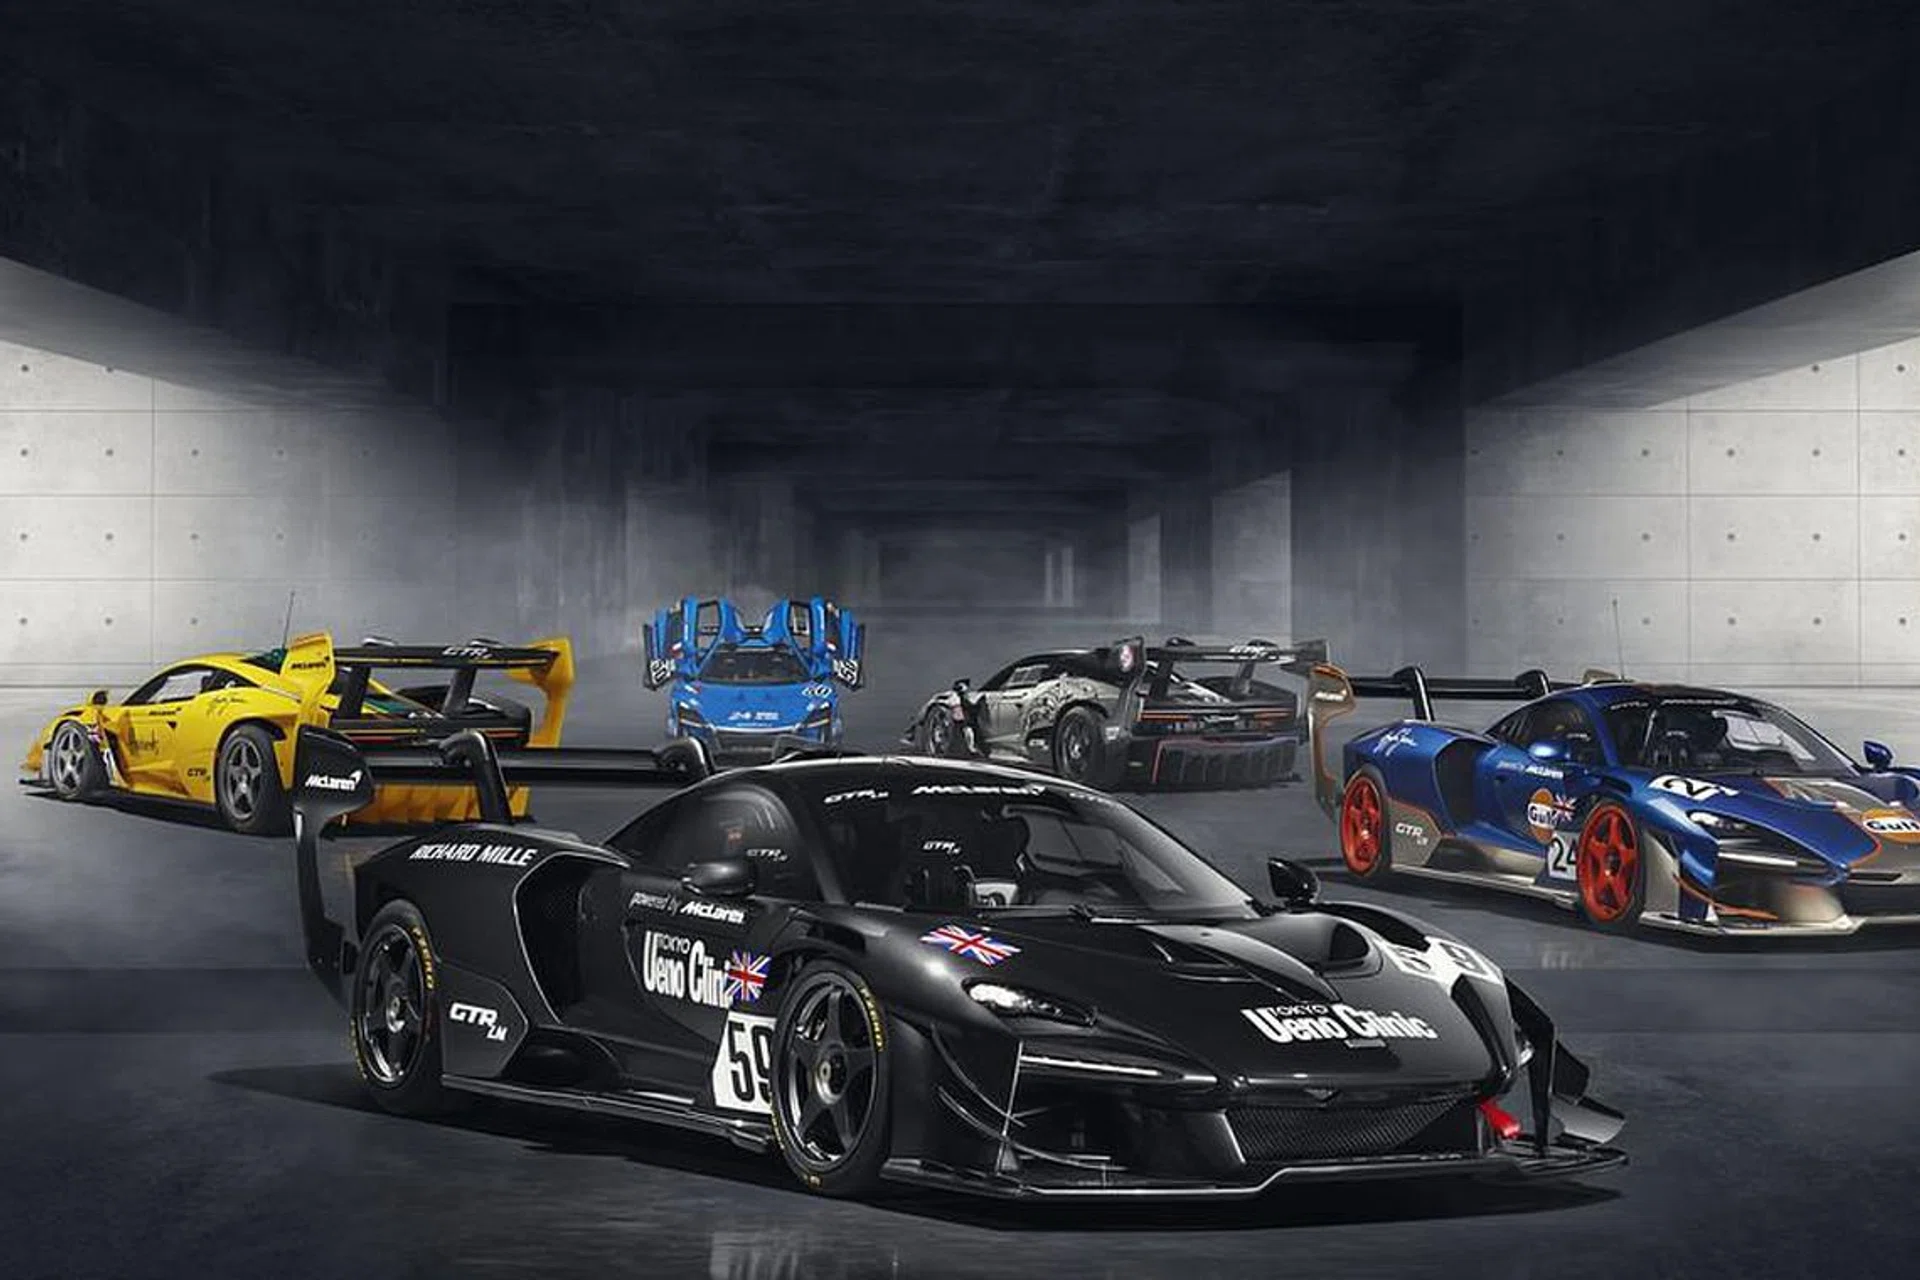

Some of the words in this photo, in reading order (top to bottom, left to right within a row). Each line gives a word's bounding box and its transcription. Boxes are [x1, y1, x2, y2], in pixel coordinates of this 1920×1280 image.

[305, 774, 355, 791] McLaren
[1396, 823, 1423, 836] GTR
[409, 843, 482, 862] RICHARD
[477, 845, 538, 866] MILLE
[1551, 836, 1577, 872] 24
[680, 901, 745, 925] McLaren
[655, 932, 691, 955] TOKYO
[643, 930, 686, 998] Ueno
[688, 939, 732, 1010] Clini
[450, 1002, 498, 1027] GTR
[1267, 1004, 1329, 1016] TOKYO
[1240, 1006, 1349, 1043] Ueno
[1331, 1003, 1439, 1039] Clinic
[728, 1020, 775, 1105] 59
